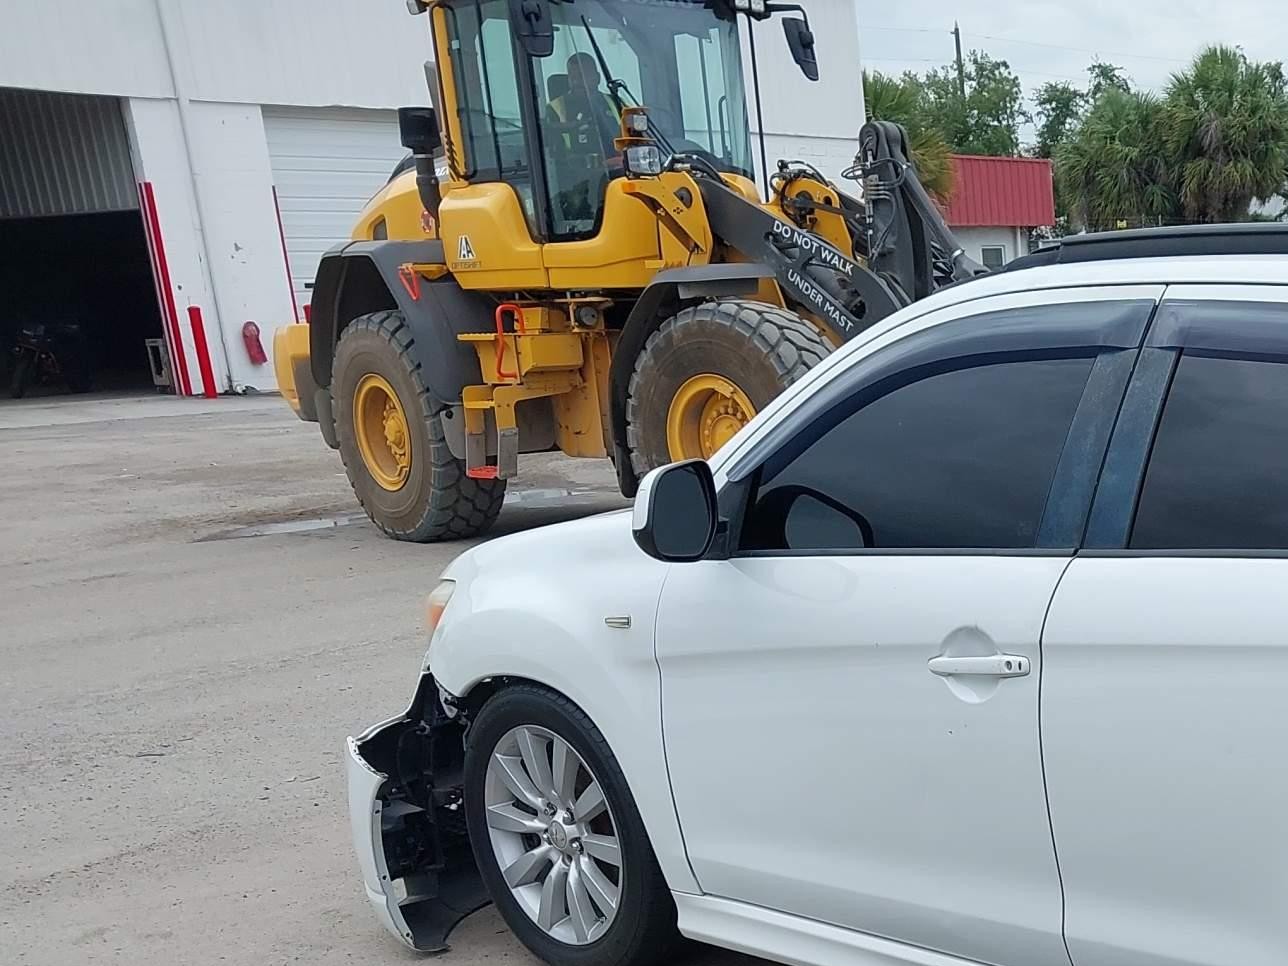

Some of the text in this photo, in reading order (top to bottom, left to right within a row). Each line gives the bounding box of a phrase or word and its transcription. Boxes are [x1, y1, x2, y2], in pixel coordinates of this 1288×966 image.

[773, 220, 854, 276] DO NOT WALK
[787, 269, 854, 332] UNDER MAST
